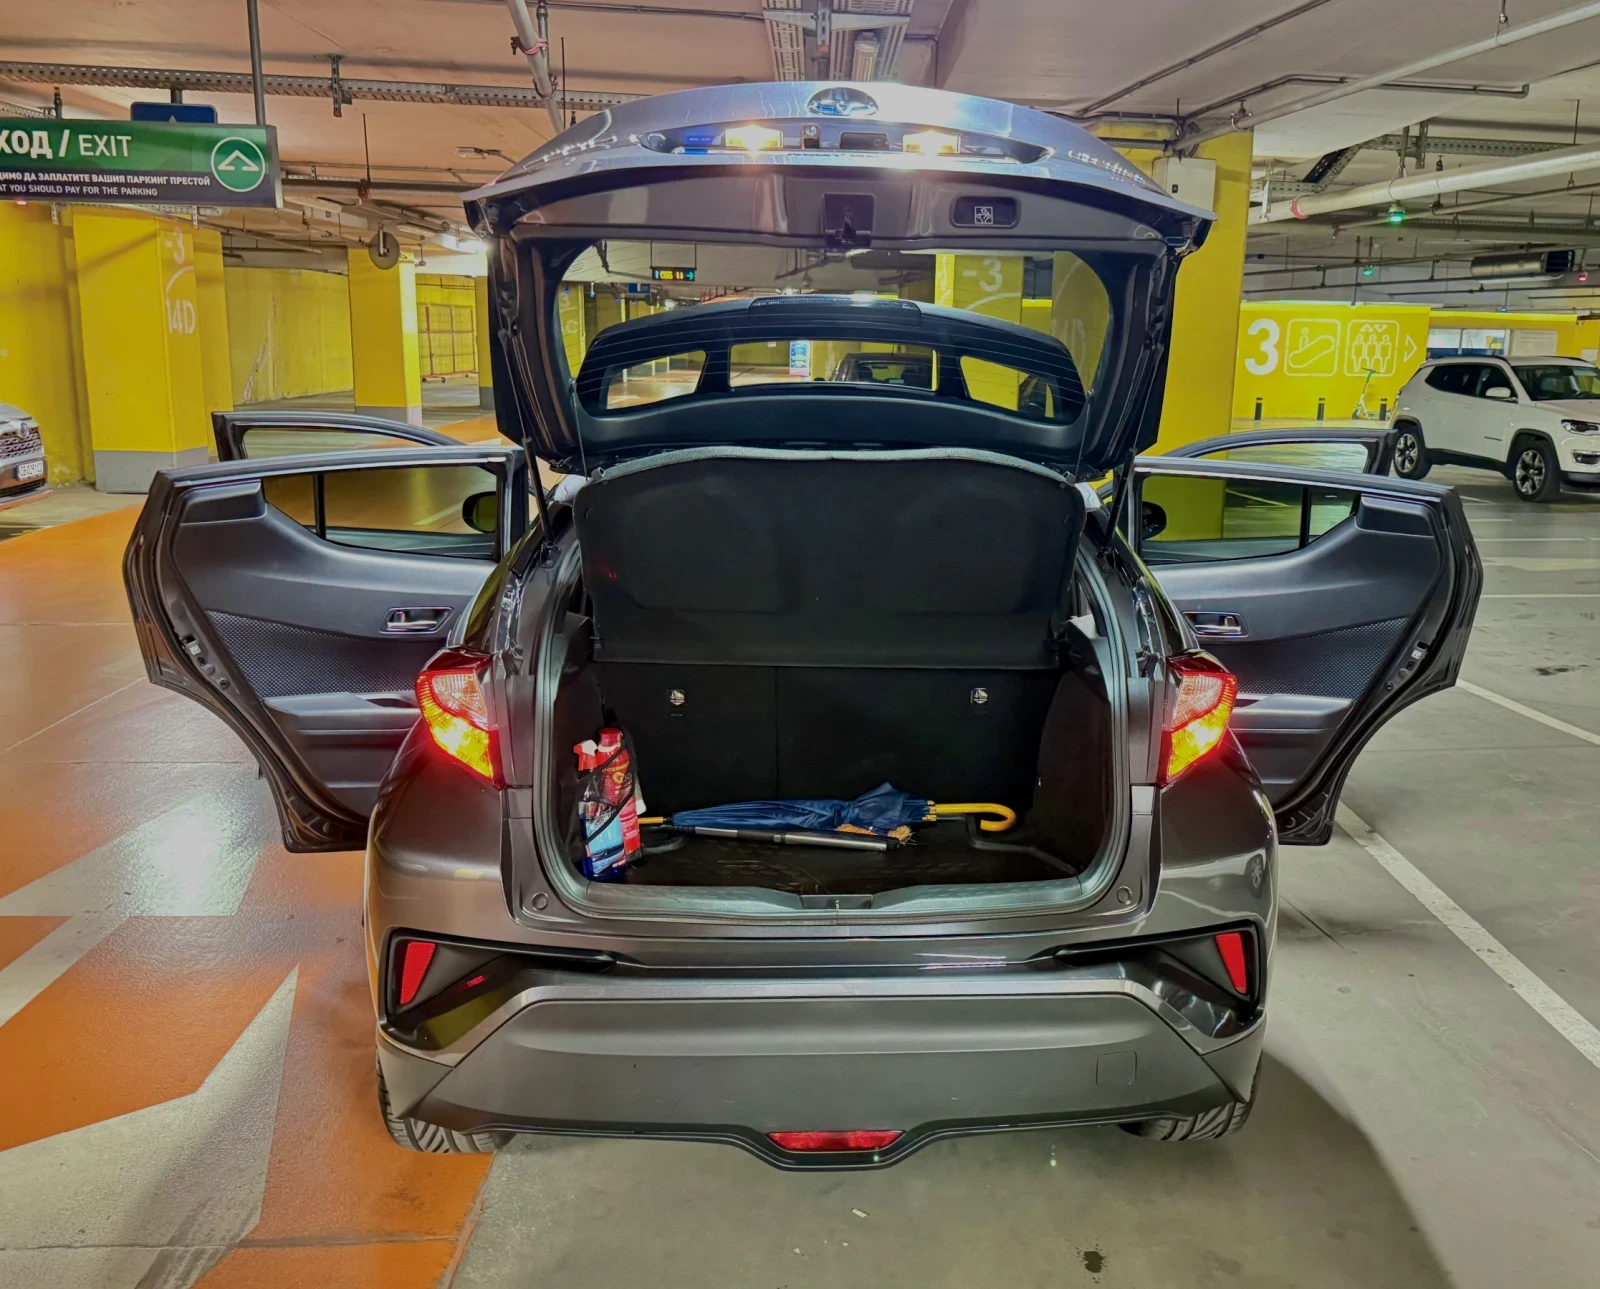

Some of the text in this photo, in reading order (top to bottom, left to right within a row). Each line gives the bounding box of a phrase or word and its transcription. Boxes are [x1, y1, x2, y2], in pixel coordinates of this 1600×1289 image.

[59, 129, 70, 157] /
[78, 134, 132, 157] EXIT
[9, 184, 26, 193] YOU
[29, 184, 63, 194] SHOULD
[65, 186, 81, 194] PAY
[83, 186, 99, 195] FOR
[102, 187, 118, 195] THE
[121, 187, 158, 197] PARKING
[23, 172, 37, 182] ДА
[39, 172, 90, 183] ЗАПЛАТИТЕ
[92, 174, 125, 184] ВАШИЯ
[127, 175, 168, 185] ПАРКИНГ
[170, 176, 211, 186] ПРЕСТОЙ
[165, 226, 185, 265] -3
[962, 256, 1003, 292] -3
[165, 299, 196, 334] 14D
[1245, 318, 1280, 376] 3
